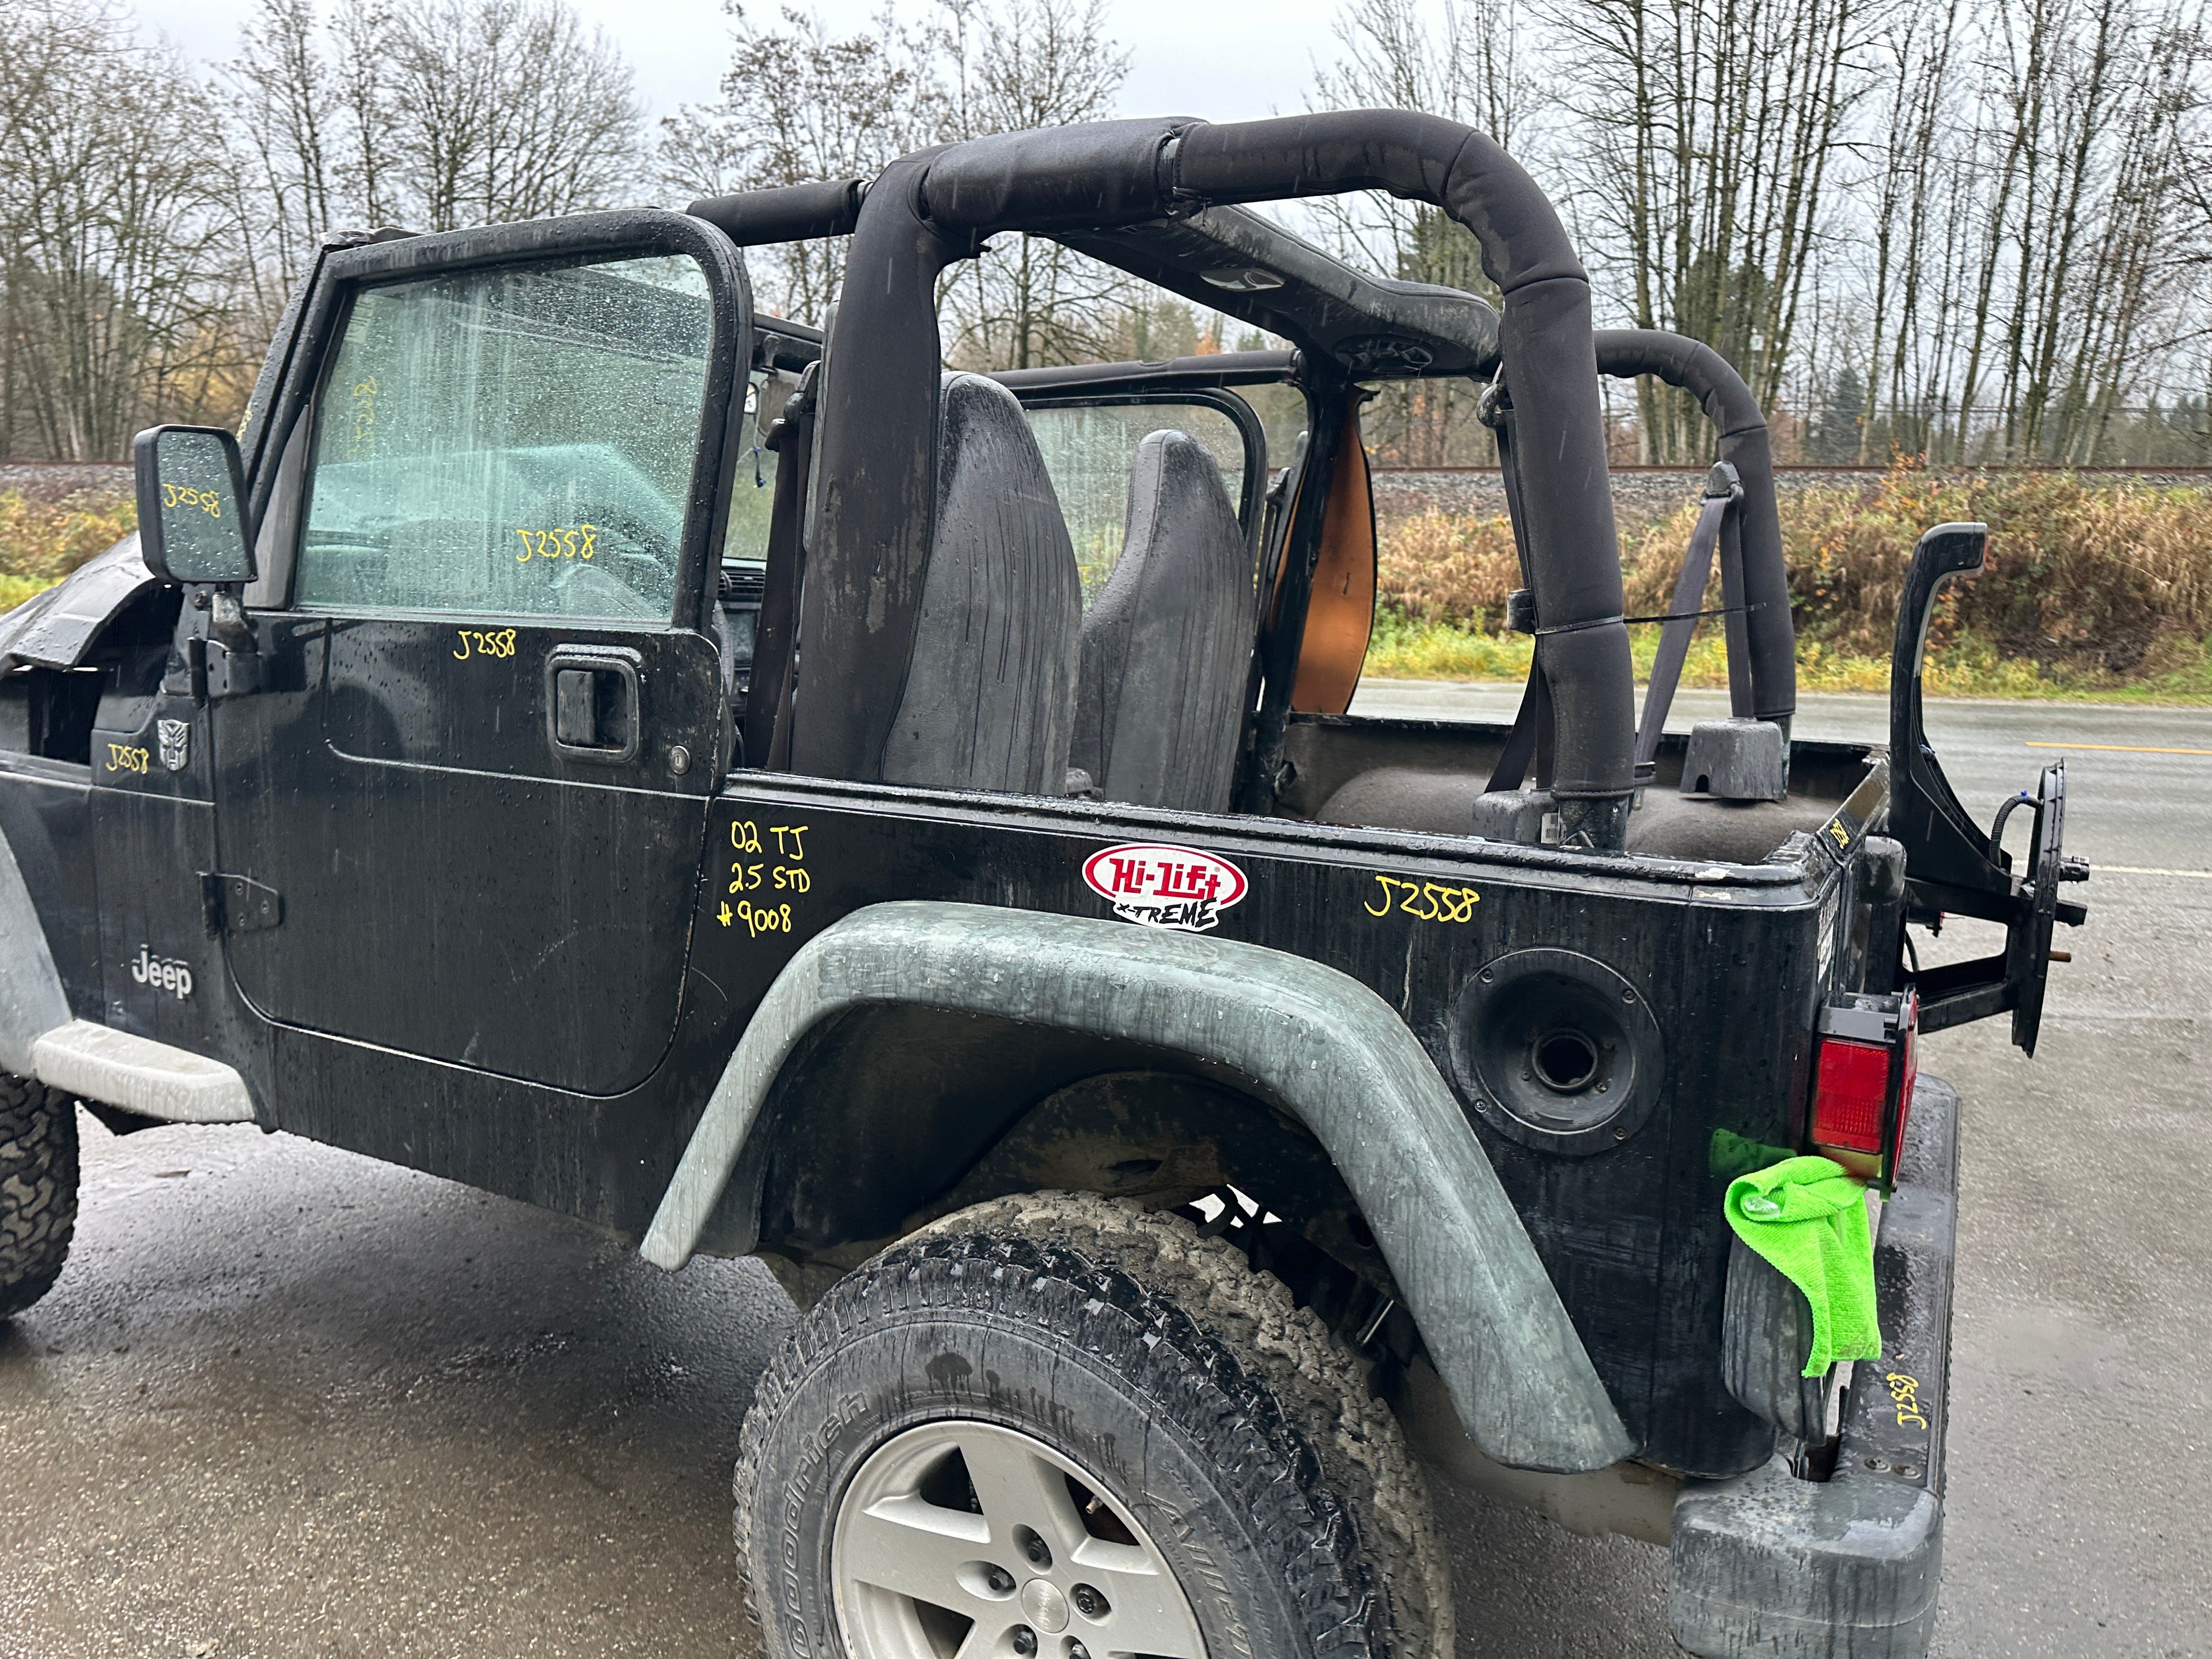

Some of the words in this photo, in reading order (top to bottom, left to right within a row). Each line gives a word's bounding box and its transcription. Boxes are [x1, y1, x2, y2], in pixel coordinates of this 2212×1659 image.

[162, 483, 221, 518] J2558
[516, 524, 597, 562] J2558
[453, 628, 516, 660] J2558
[731, 821, 763, 853] 02
[769, 825, 809, 860] TJ
[729, 862, 764, 893] 2.5
[772, 866, 810, 893] STD
[1109, 858, 1221, 901] Hi-Lift
[1364, 875, 1480, 923] J2558
[131, 944, 192, 999] Jeep
[1886, 1372, 1927, 1430] J2558
